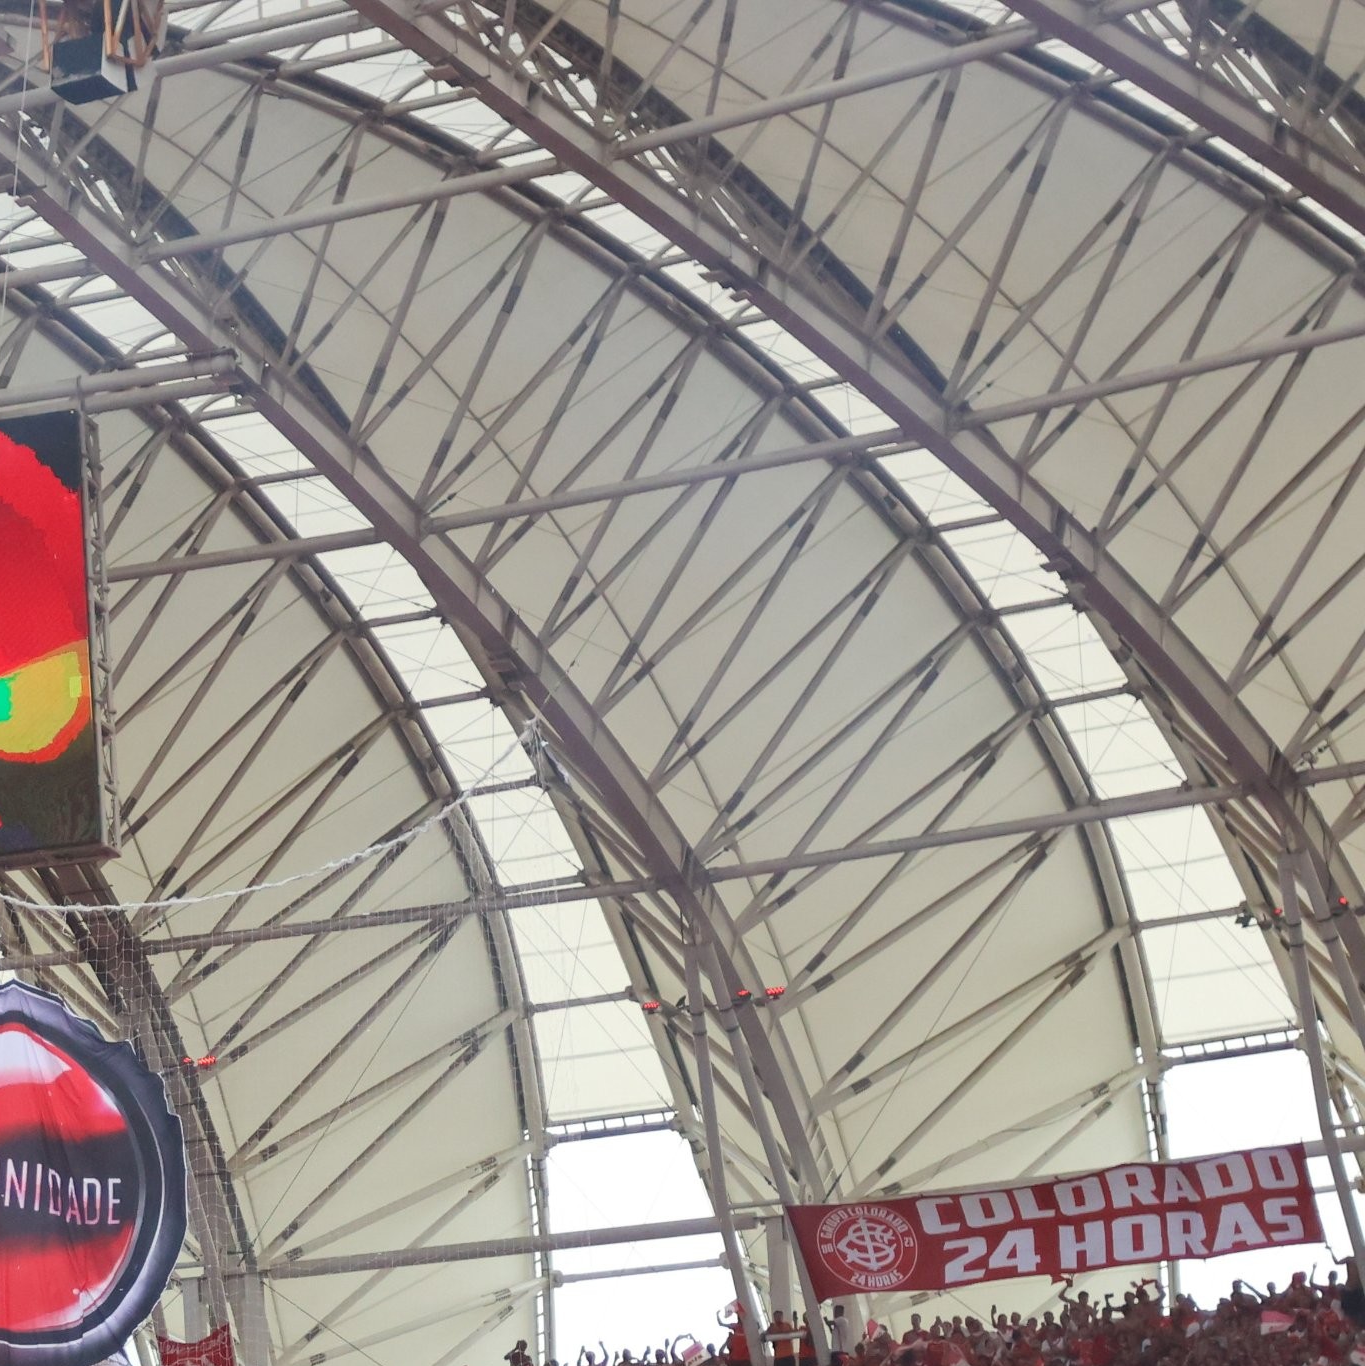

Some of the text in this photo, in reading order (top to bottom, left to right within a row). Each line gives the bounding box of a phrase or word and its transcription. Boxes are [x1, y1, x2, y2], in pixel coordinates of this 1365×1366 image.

[916, 1147, 1300, 1235] COLORADO
[944, 1197, 1304, 1284] 24 HORAS
